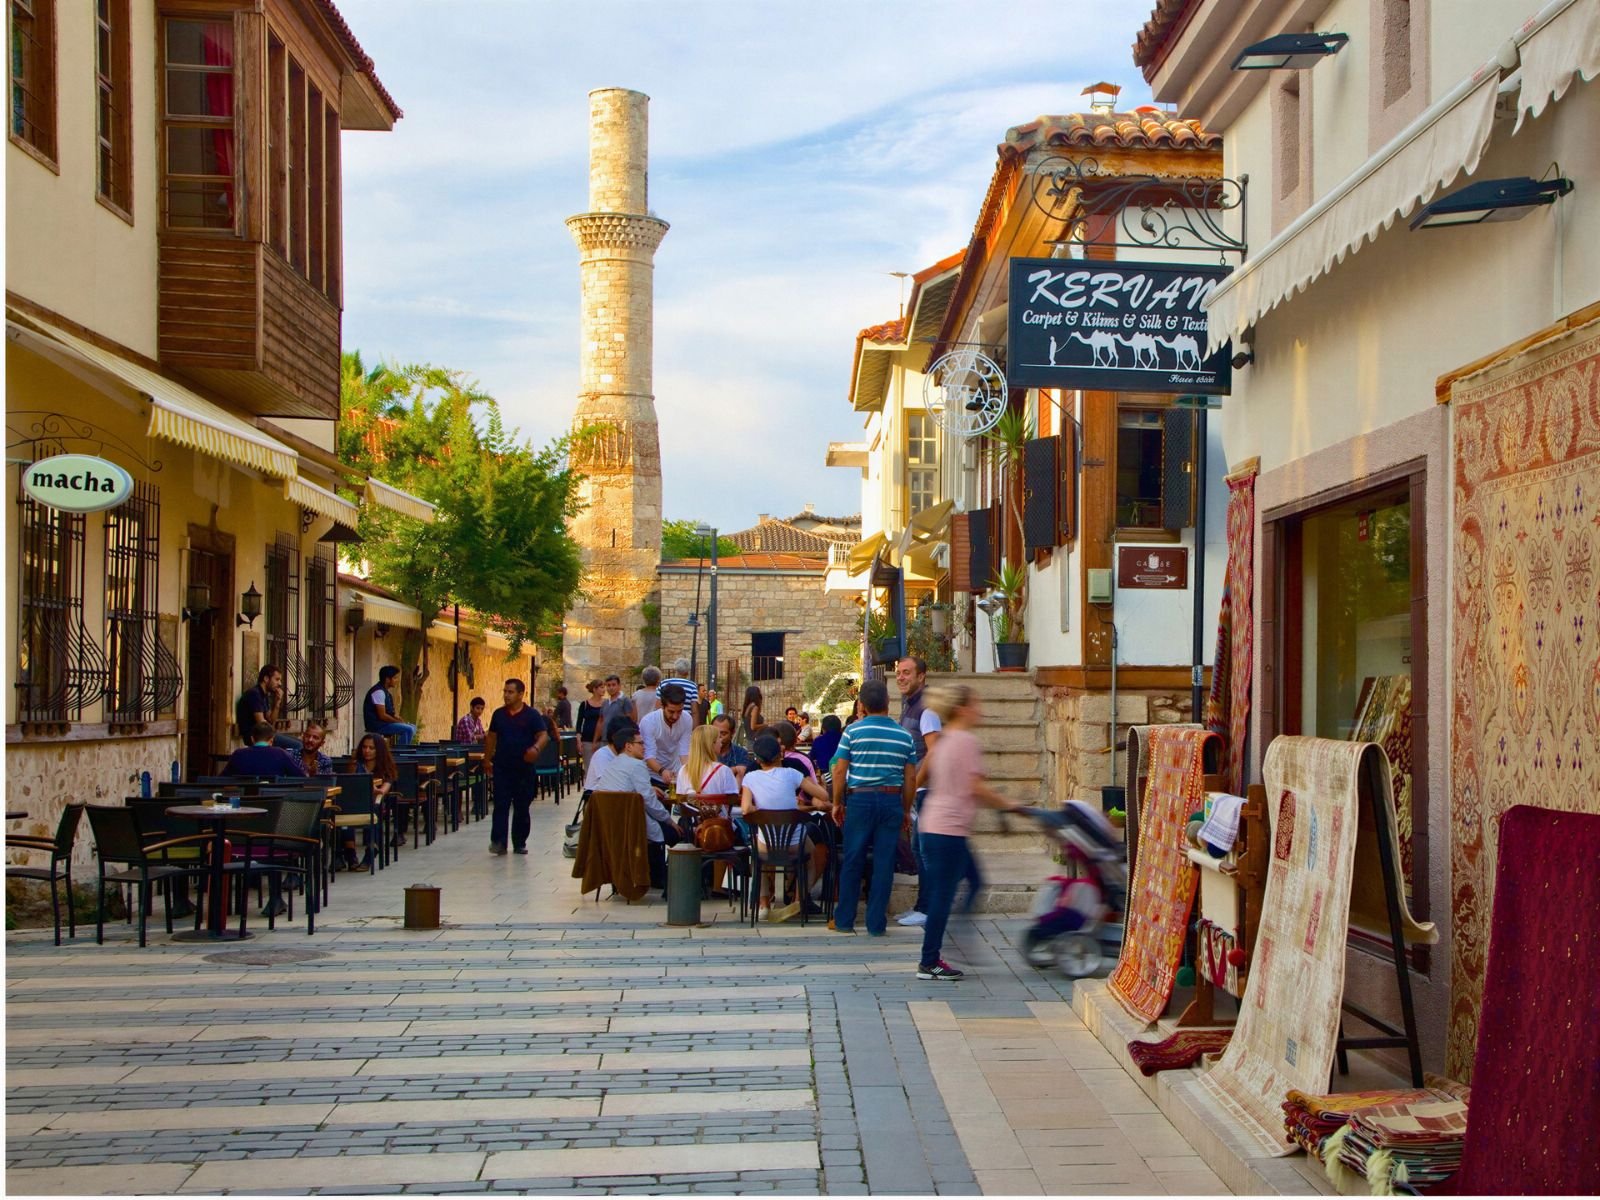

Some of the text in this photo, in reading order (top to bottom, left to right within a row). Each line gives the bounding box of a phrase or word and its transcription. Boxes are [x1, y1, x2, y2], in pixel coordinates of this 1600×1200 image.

[1027, 269, 1217, 313] KERVAN
[1022, 309, 1208, 332] Carpet & Kilims & Silk & Texti
[32, 471, 115, 493] macha
